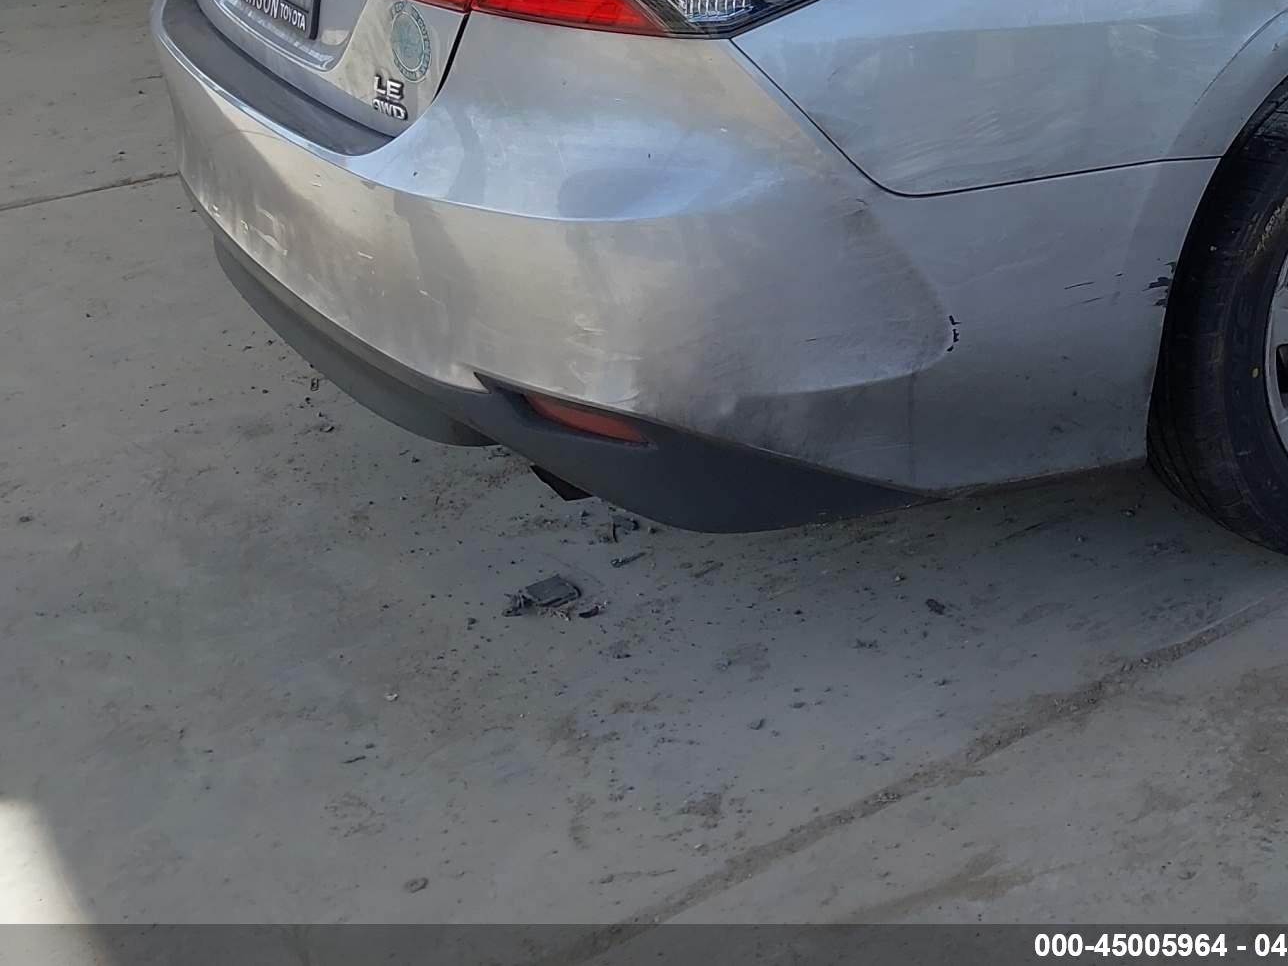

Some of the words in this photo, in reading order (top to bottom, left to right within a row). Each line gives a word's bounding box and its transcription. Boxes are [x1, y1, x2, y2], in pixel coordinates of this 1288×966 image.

[280, 2, 306, 31] TOYOTA
[373, 74, 404, 100] LE
[372, 97, 408, 120] AWD
